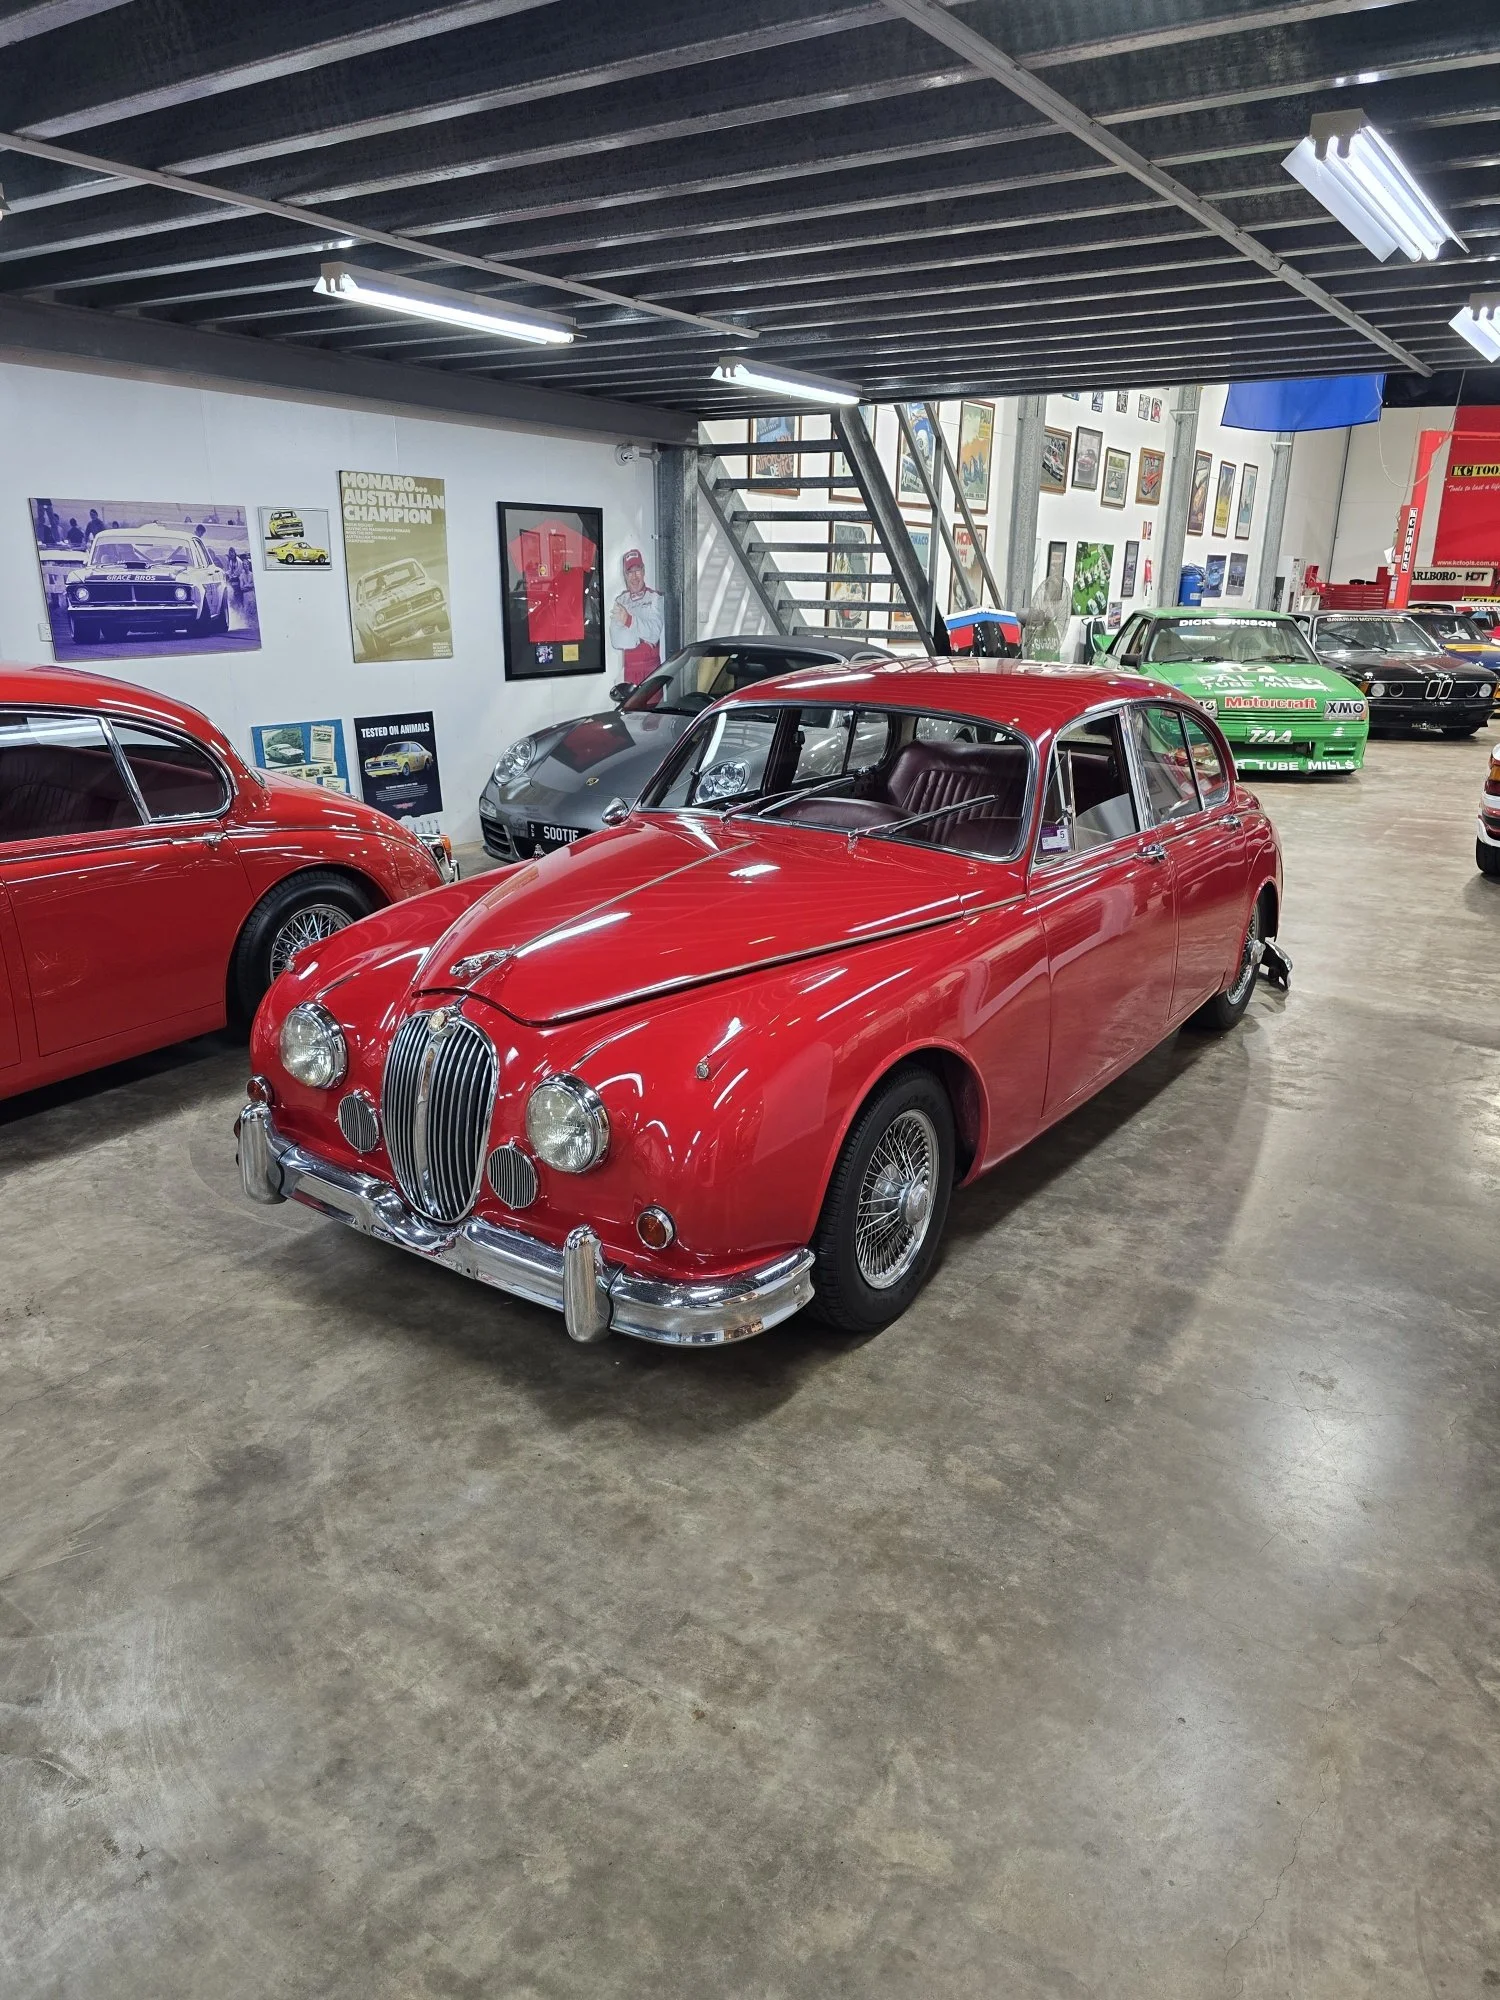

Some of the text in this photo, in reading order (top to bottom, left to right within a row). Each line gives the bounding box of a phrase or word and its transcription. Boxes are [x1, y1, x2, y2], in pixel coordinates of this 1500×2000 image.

[1474, 465, 1500, 475] TOO
[341, 471, 427, 492] MONARO...
[343, 488, 445, 510] AUSTRALIAN
[343, 505, 433, 525] CHAMPION
[1412, 572, 1456, 581] ARLBORO
[1179, 619, 1276, 627] DICK HNSON
[1197, 674, 1324, 685] PALMER
[1225, 697, 1317, 709] Motorcraft
[361, 722, 430, 738] TESTED ON ANIMALS
[1249, 729, 1293, 743] TAA
[1256, 761, 1299, 771] TUBE
[1308, 760, 1355, 770] MILLS
